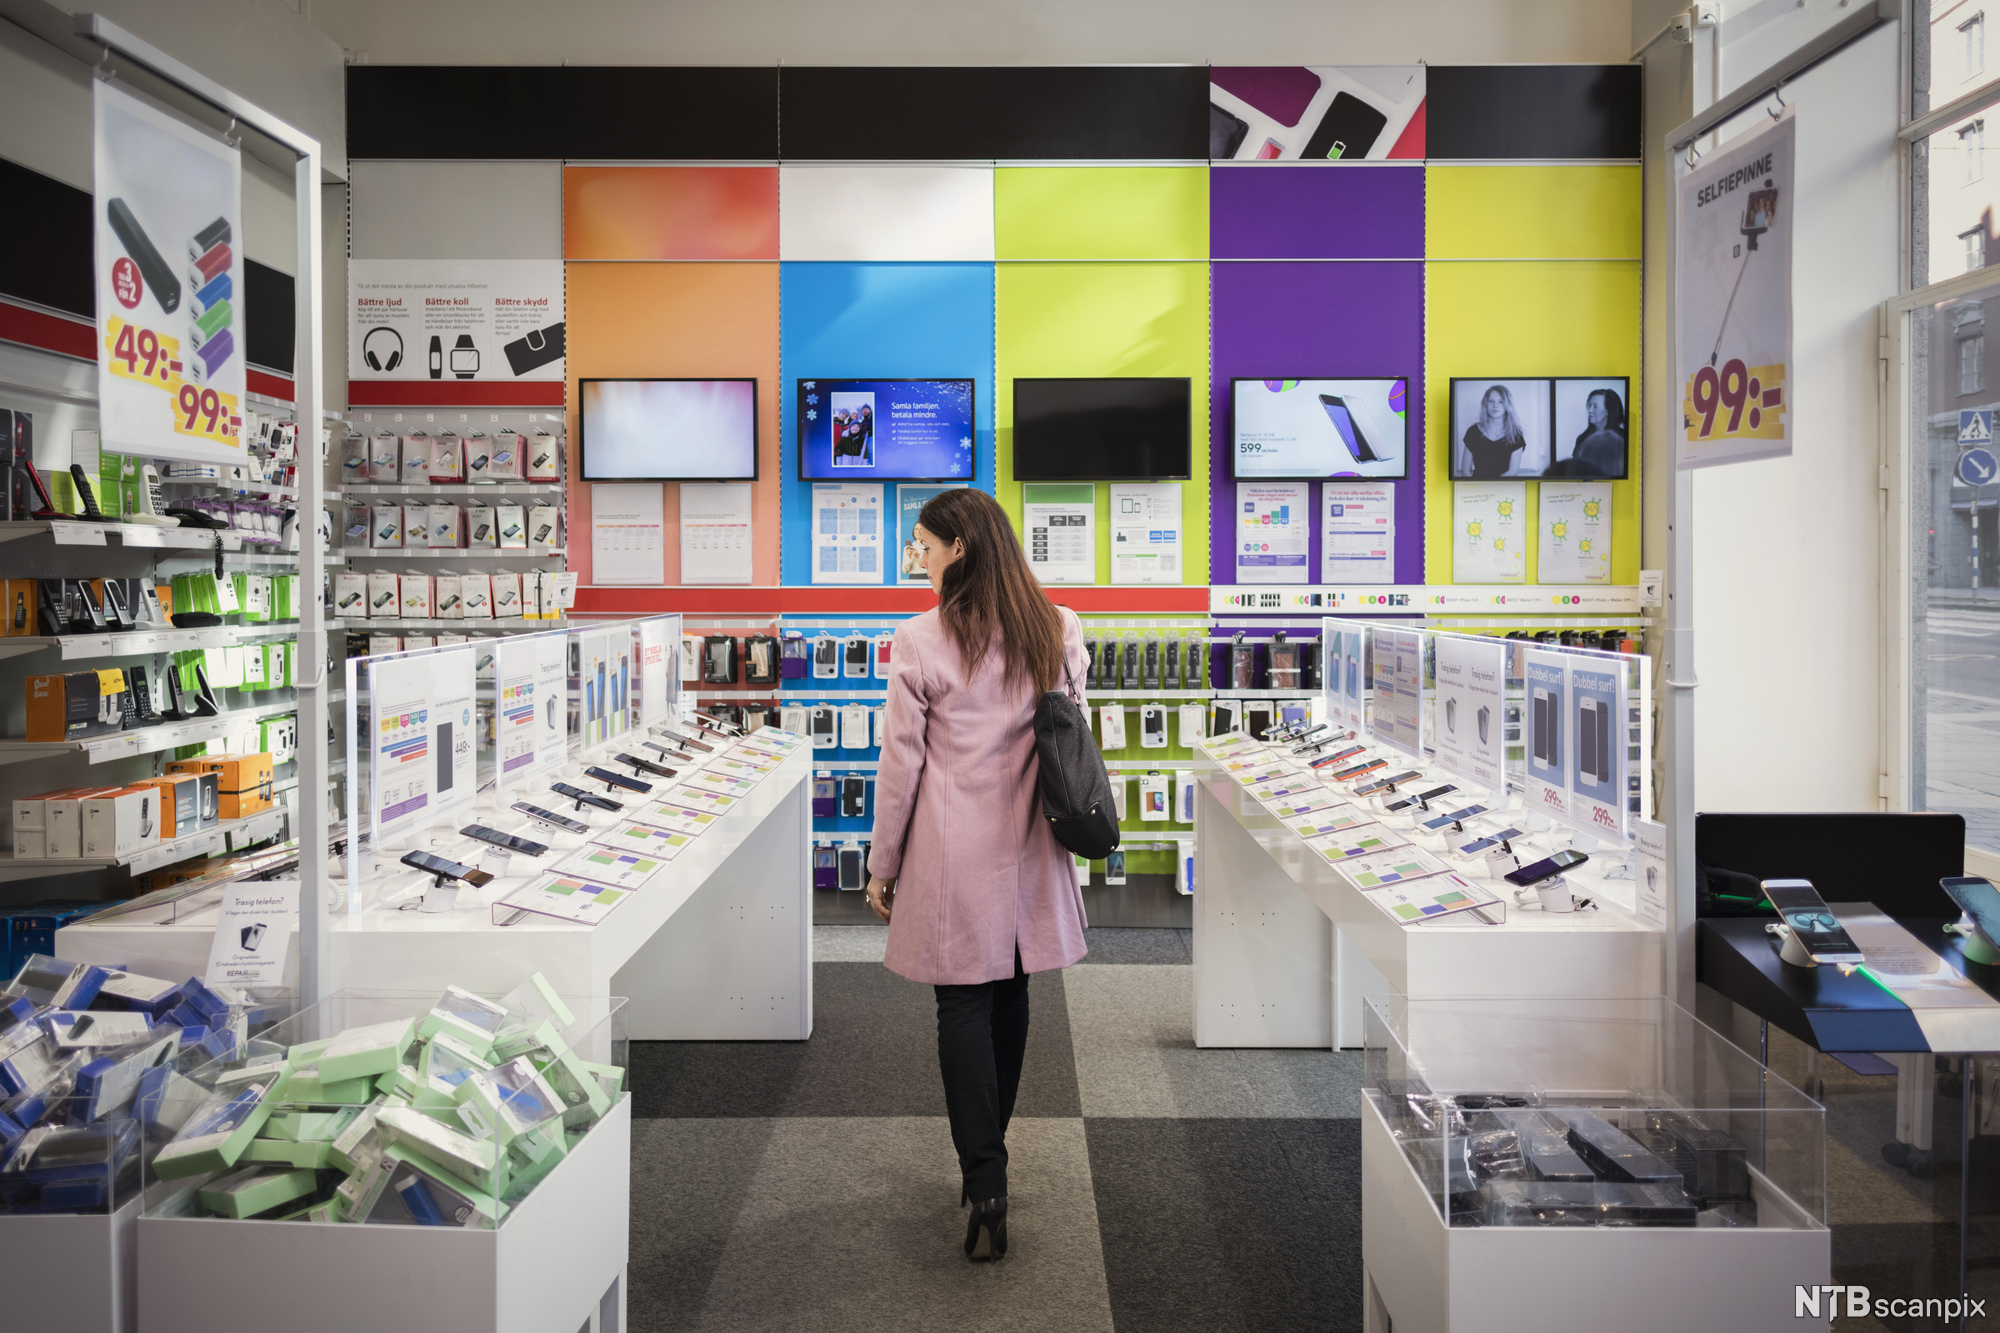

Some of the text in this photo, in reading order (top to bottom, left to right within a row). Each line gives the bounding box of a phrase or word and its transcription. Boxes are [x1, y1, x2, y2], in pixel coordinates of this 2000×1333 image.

[1697, 153, 1772, 208] SELFIEPINNE
[125, 262, 132, 282] 3
[129, 281, 136, 302] 2
[358, 298, 402, 307] Bättre ljud
[425, 298, 451, 306] Bättre
[495, 298, 548, 307] Bättre skydd
[114, 323, 183, 381] 49:-
[913, 402, 940, 410] familjen,
[1693, 358, 1781, 438] 99:-
[179, 384, 242, 436] 99:-
[1240, 443, 1262, 453] 599
[1528, 666, 1564, 685] Dubbel surf!
[1573, 674, 1615, 694] Dubbel surf!
[1544, 787, 1562, 808] 299:-
[1593, 806, 1614, 827] 299:-
[235, 897, 284, 907] Trasig telefon?
